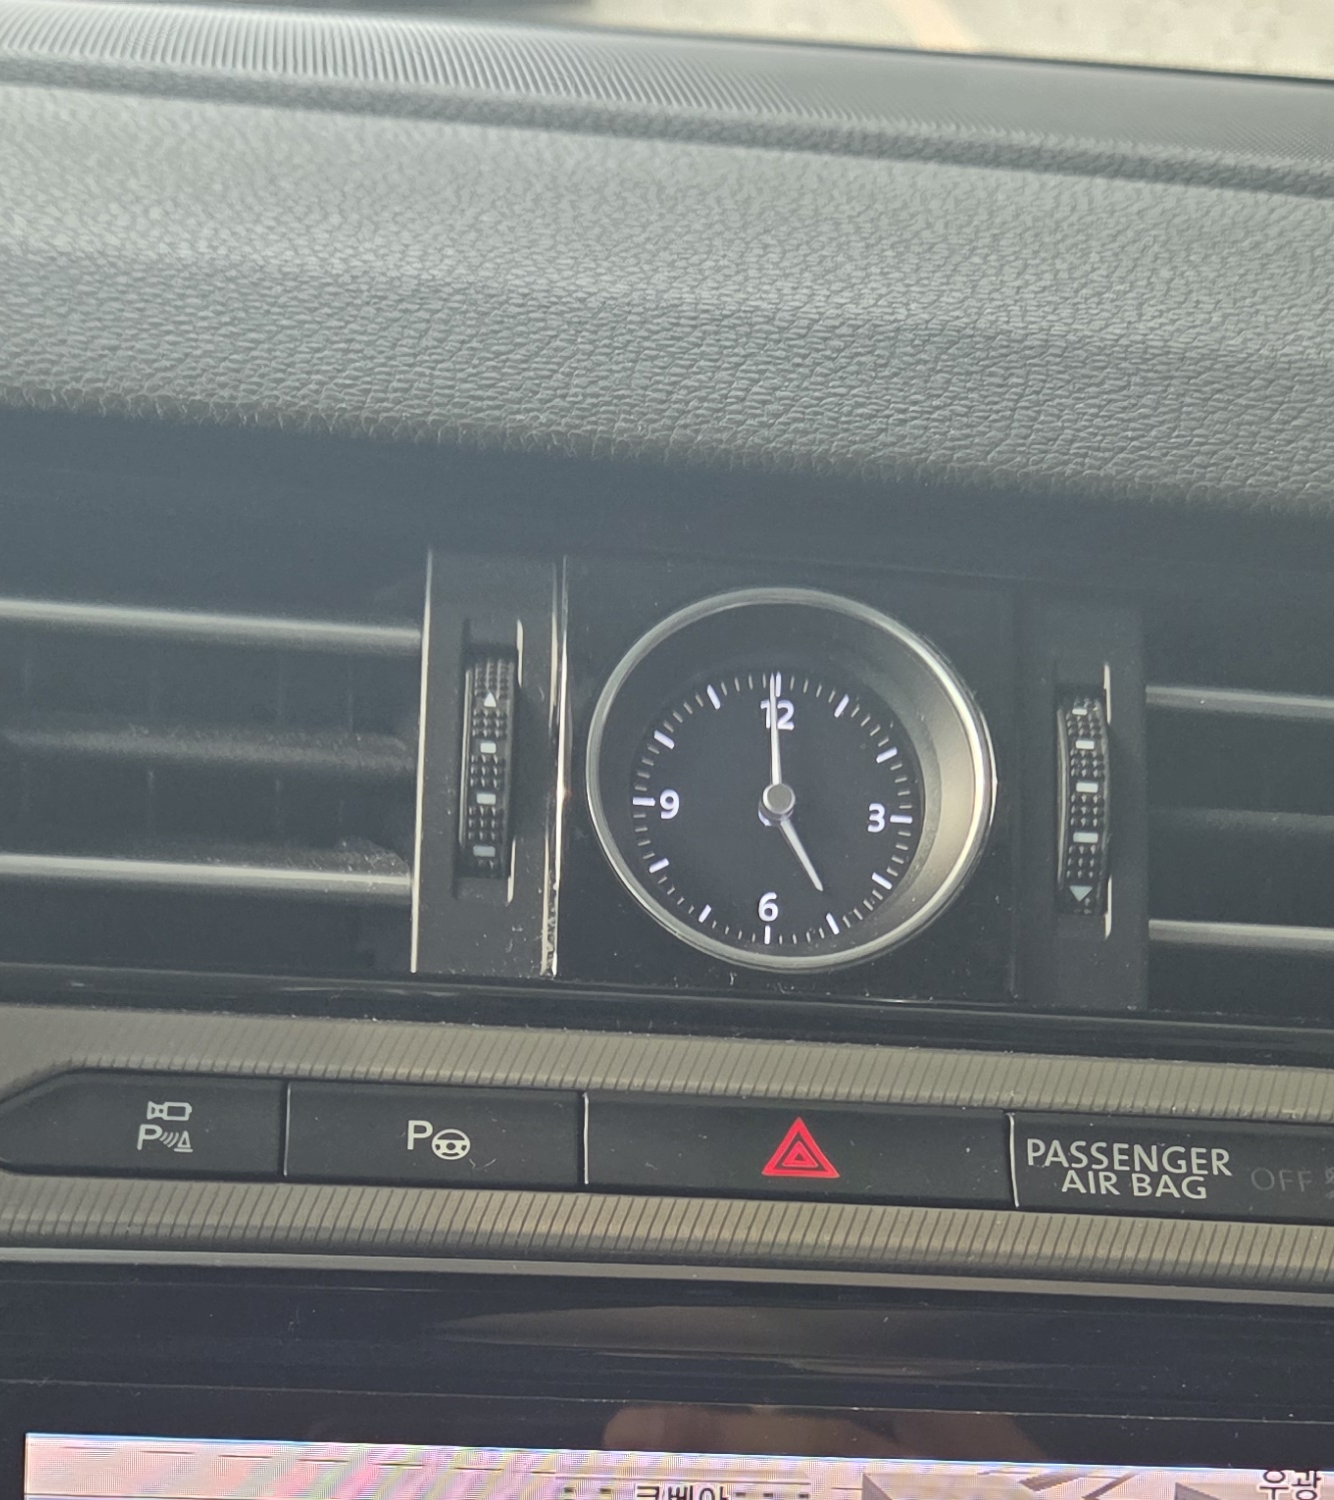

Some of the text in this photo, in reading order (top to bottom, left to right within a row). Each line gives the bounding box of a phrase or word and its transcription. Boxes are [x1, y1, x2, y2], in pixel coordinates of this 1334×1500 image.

[760, 699, 794, 730] 12
[659, 789, 680, 820] 9
[867, 803, 886, 833] 3
[758, 892, 778, 922] 6
[1026, 1138, 1233, 1177] PASSENGER
[1061, 1169, 1207, 1200] AIR BAG
[1251, 1166, 1313, 1193] OFF
